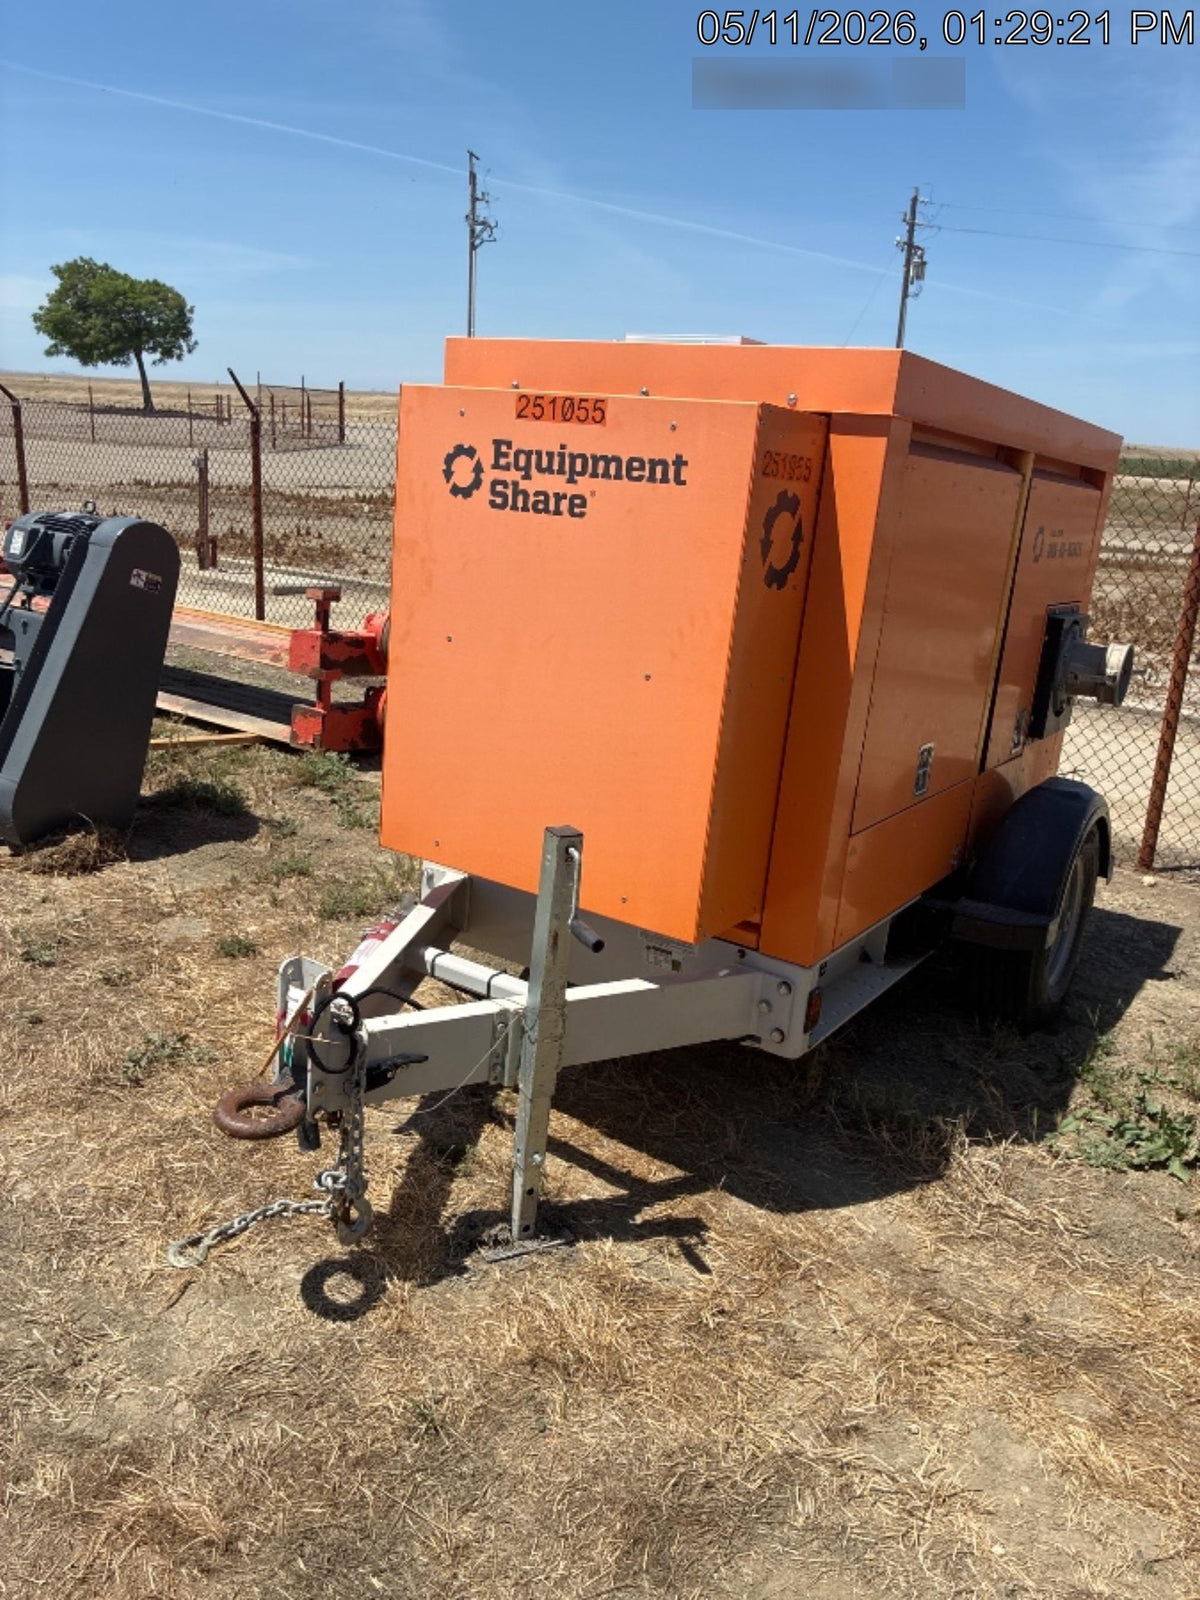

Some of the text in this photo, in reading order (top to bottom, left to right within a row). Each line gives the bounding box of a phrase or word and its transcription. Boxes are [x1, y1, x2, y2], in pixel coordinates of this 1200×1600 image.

[516, 394, 606, 424] 251055
[491, 438, 689, 486] Equipment
[488, 478, 588, 519] Share
